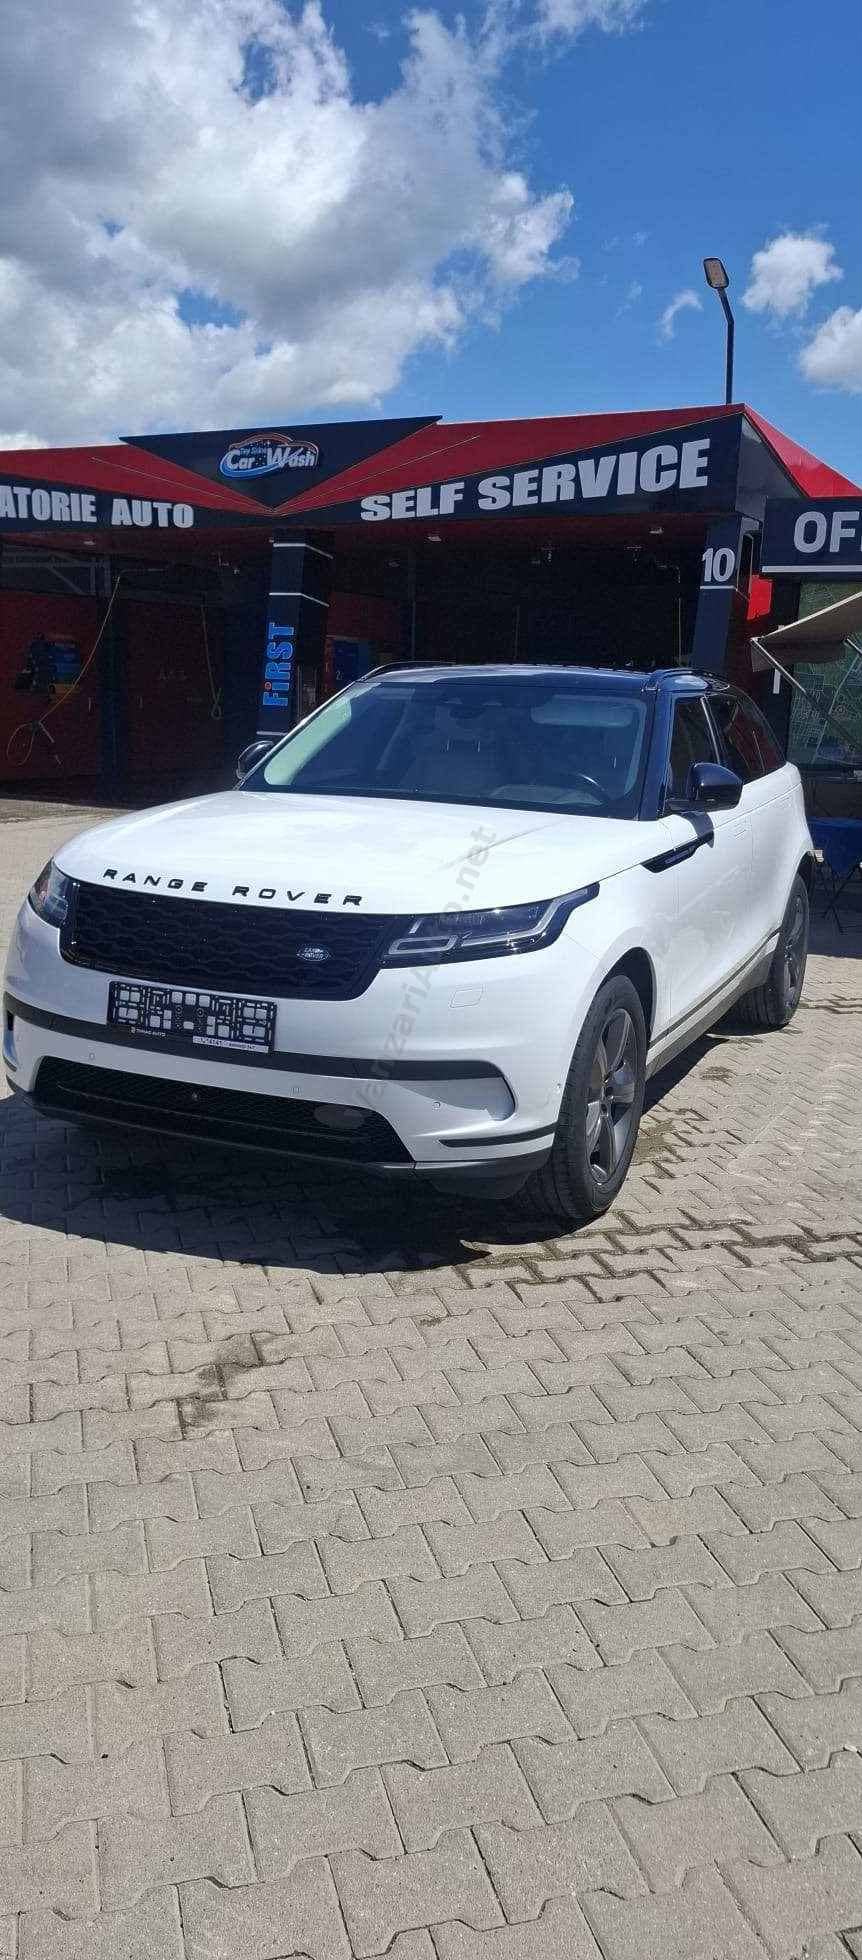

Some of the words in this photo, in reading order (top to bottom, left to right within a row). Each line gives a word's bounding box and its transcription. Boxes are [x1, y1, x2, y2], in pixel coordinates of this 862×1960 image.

[227, 449, 256, 469] Car
[266, 447, 316, 468] Wash
[360, 482, 465, 521] SELF
[477, 438, 711, 511] SERVICE
[0, 485, 97, 523] ATORIE
[111, 498, 195, 529] AUTO
[794, 511, 862, 553] OF
[702, 547, 735, 582] 10
[102, 868, 208, 893] RANGE
[231, 885, 363, 907] ROVER
